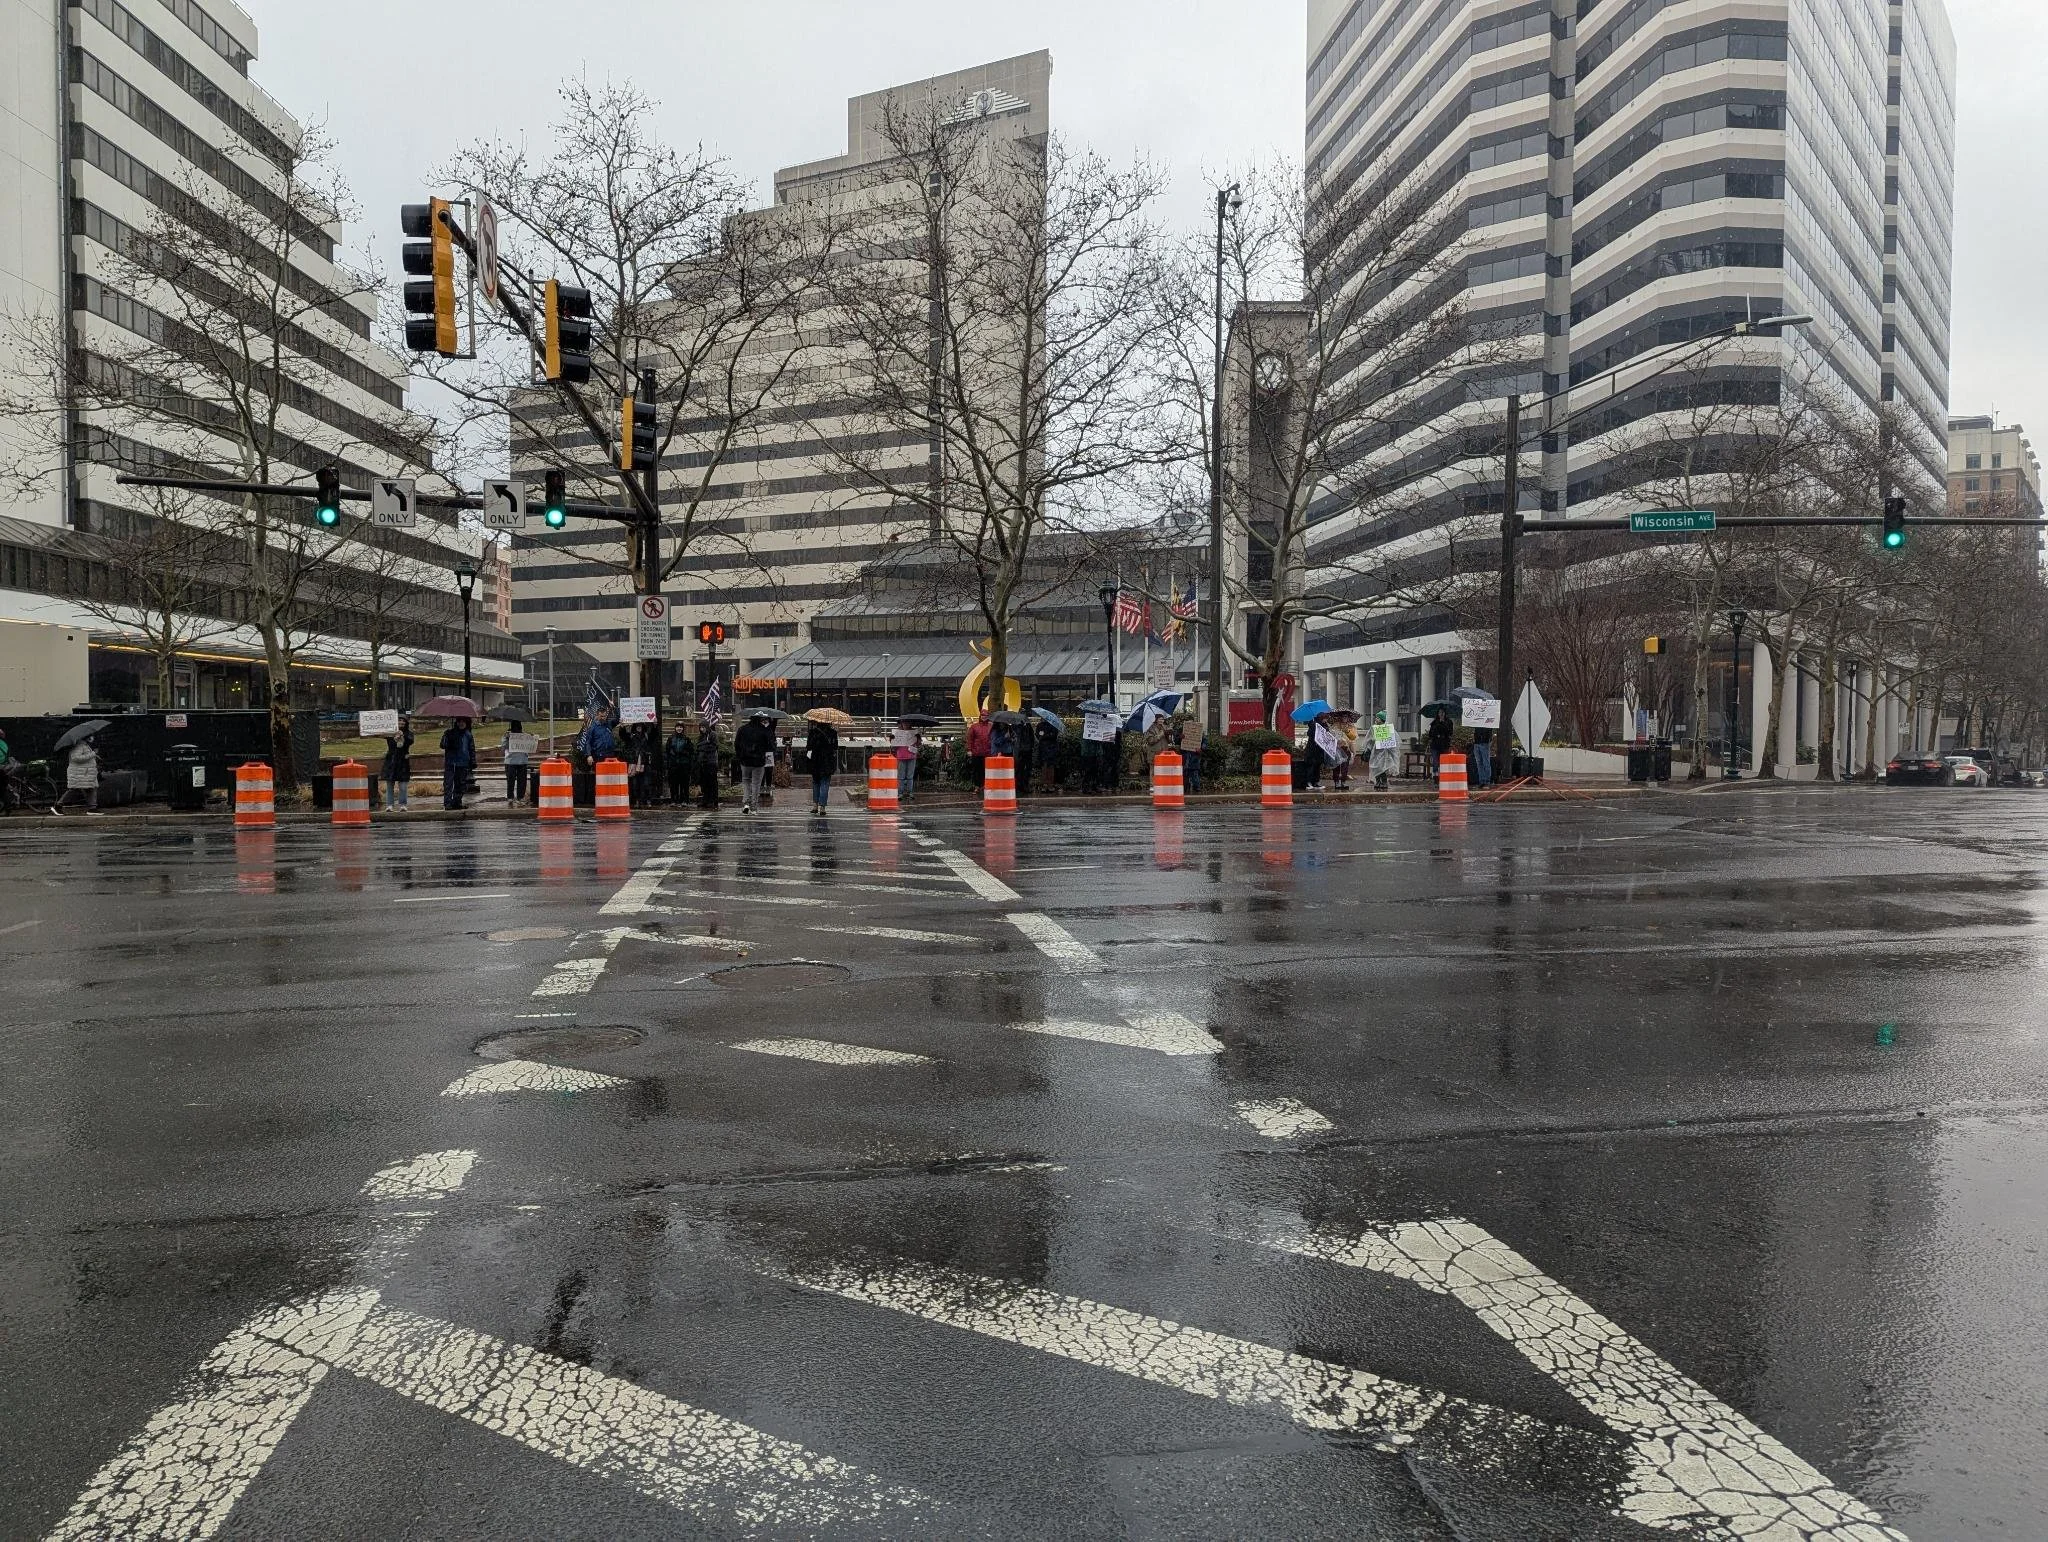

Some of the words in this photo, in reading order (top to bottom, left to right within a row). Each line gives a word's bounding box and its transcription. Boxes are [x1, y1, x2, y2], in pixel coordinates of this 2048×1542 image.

[378, 513, 409, 524] ONLY
[489, 514, 520, 525] ONLY
[1634, 515, 1695, 528] Wisconsin
[716, 626, 723, 640] 9
[752, 678, 787, 689] MUSEUM
